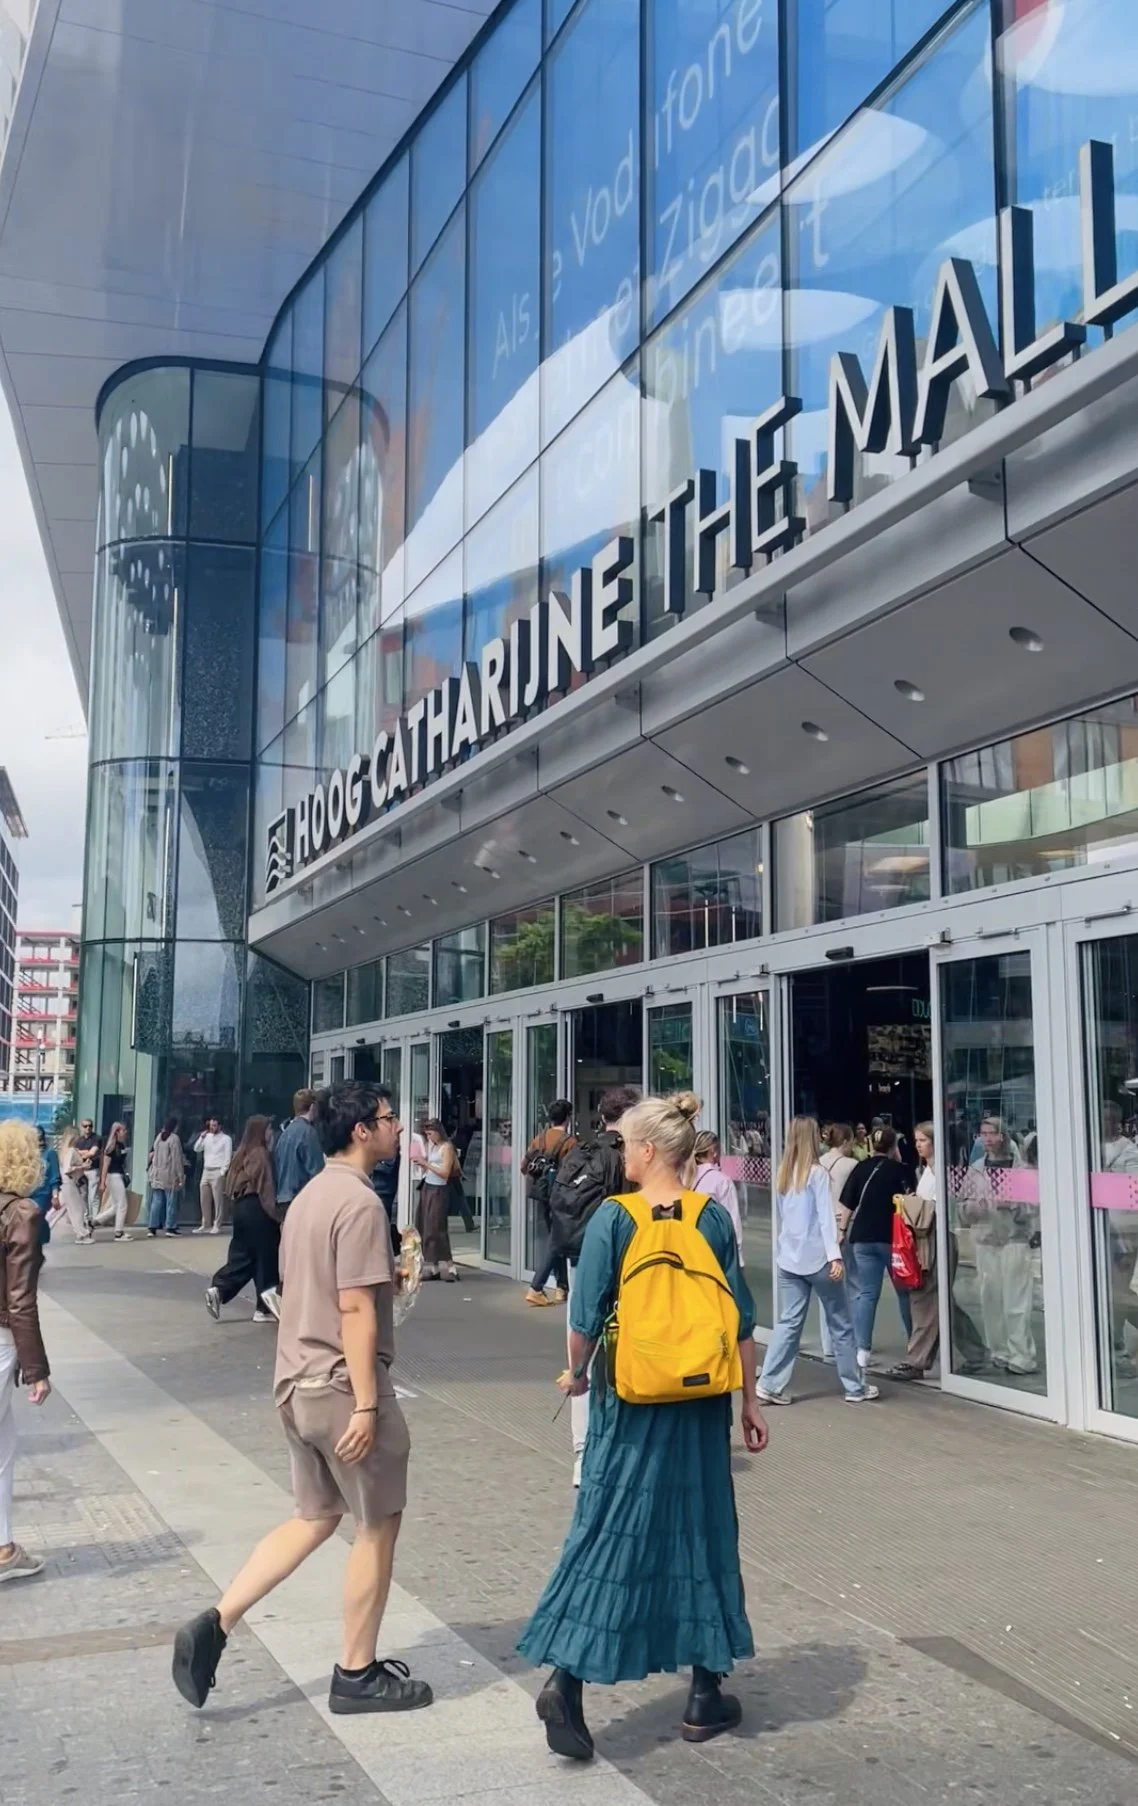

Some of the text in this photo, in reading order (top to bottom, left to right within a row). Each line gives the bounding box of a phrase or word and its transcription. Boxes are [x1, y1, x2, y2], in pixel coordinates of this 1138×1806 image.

[569, 0, 763, 268] Vodfone
[294, 139, 1138, 863] HOOG CATHARIJNE THE MALL
